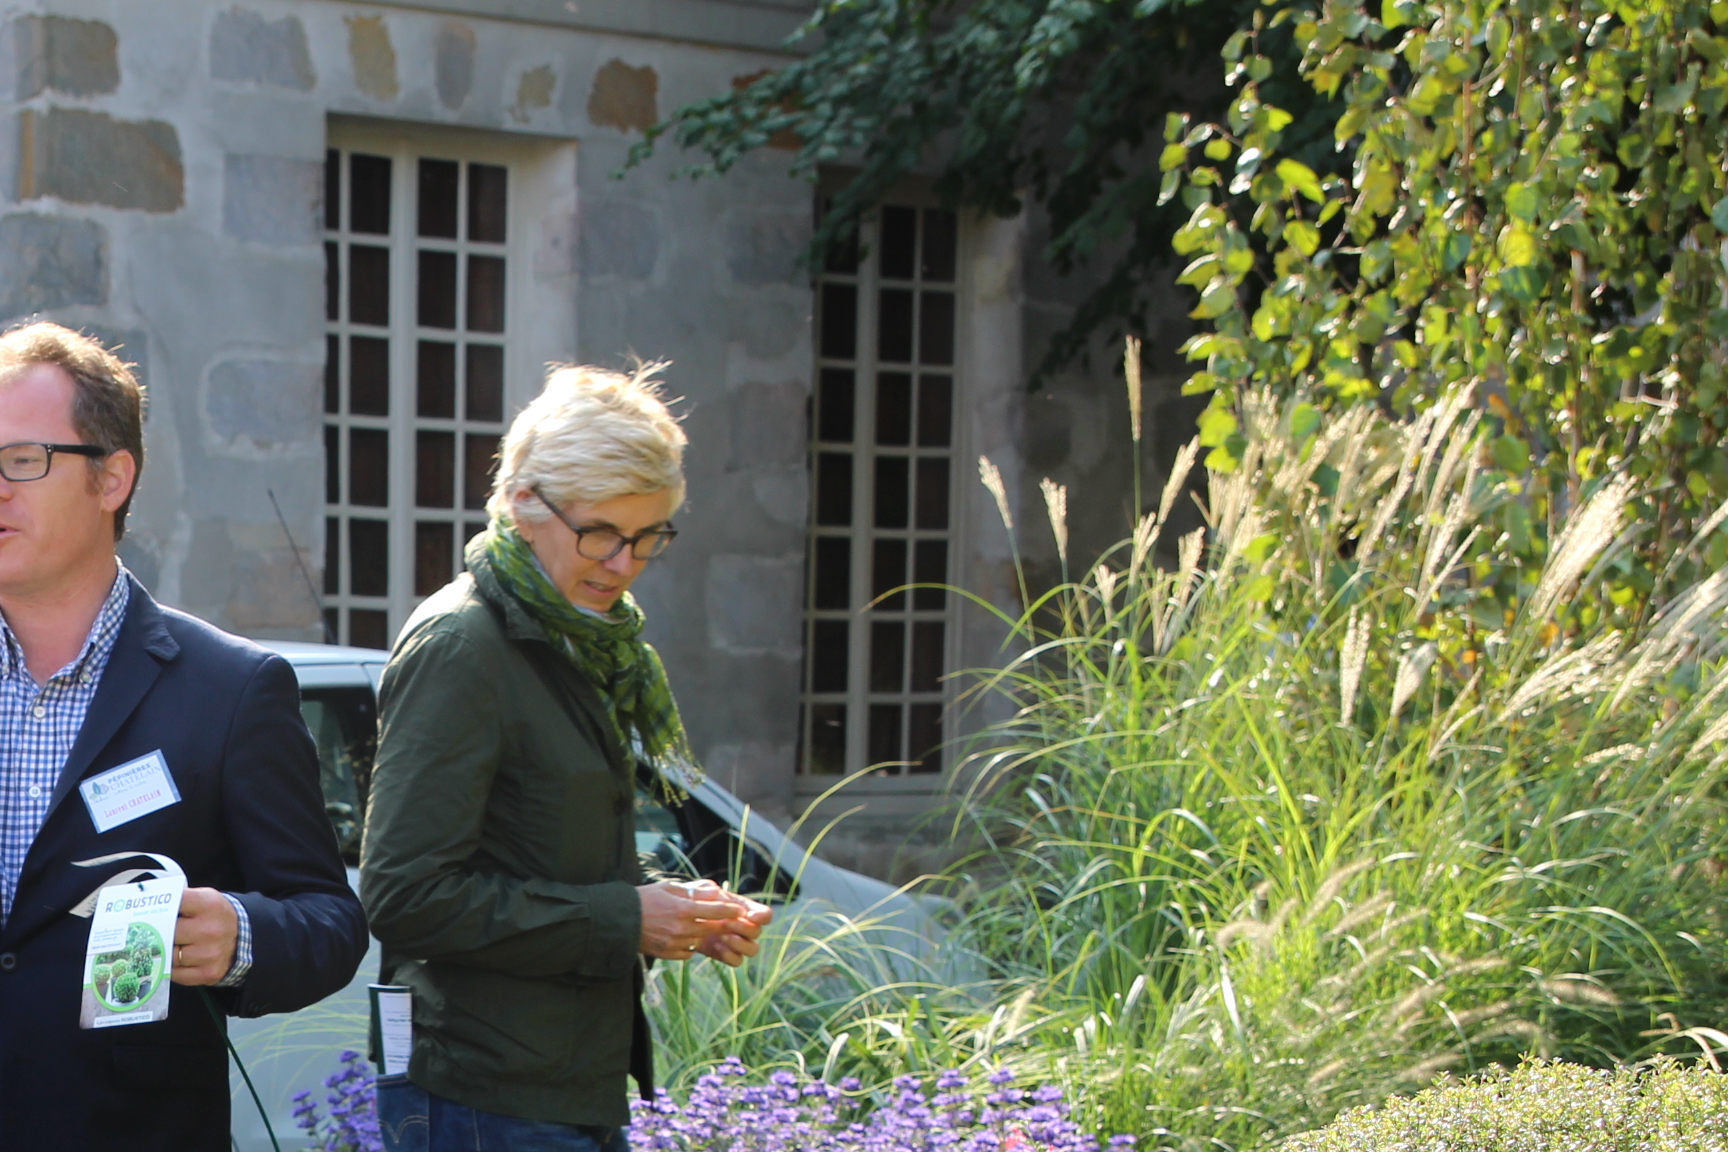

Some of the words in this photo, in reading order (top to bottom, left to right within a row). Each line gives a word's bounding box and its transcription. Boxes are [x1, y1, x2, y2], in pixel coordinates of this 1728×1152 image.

[108, 763, 151, 784] PÉPINIÈRES
[104, 803, 128, 818] Laurent
[128, 790, 161, 808] CHATELAIN
[105, 893, 172, 913] ROBUSTICO
